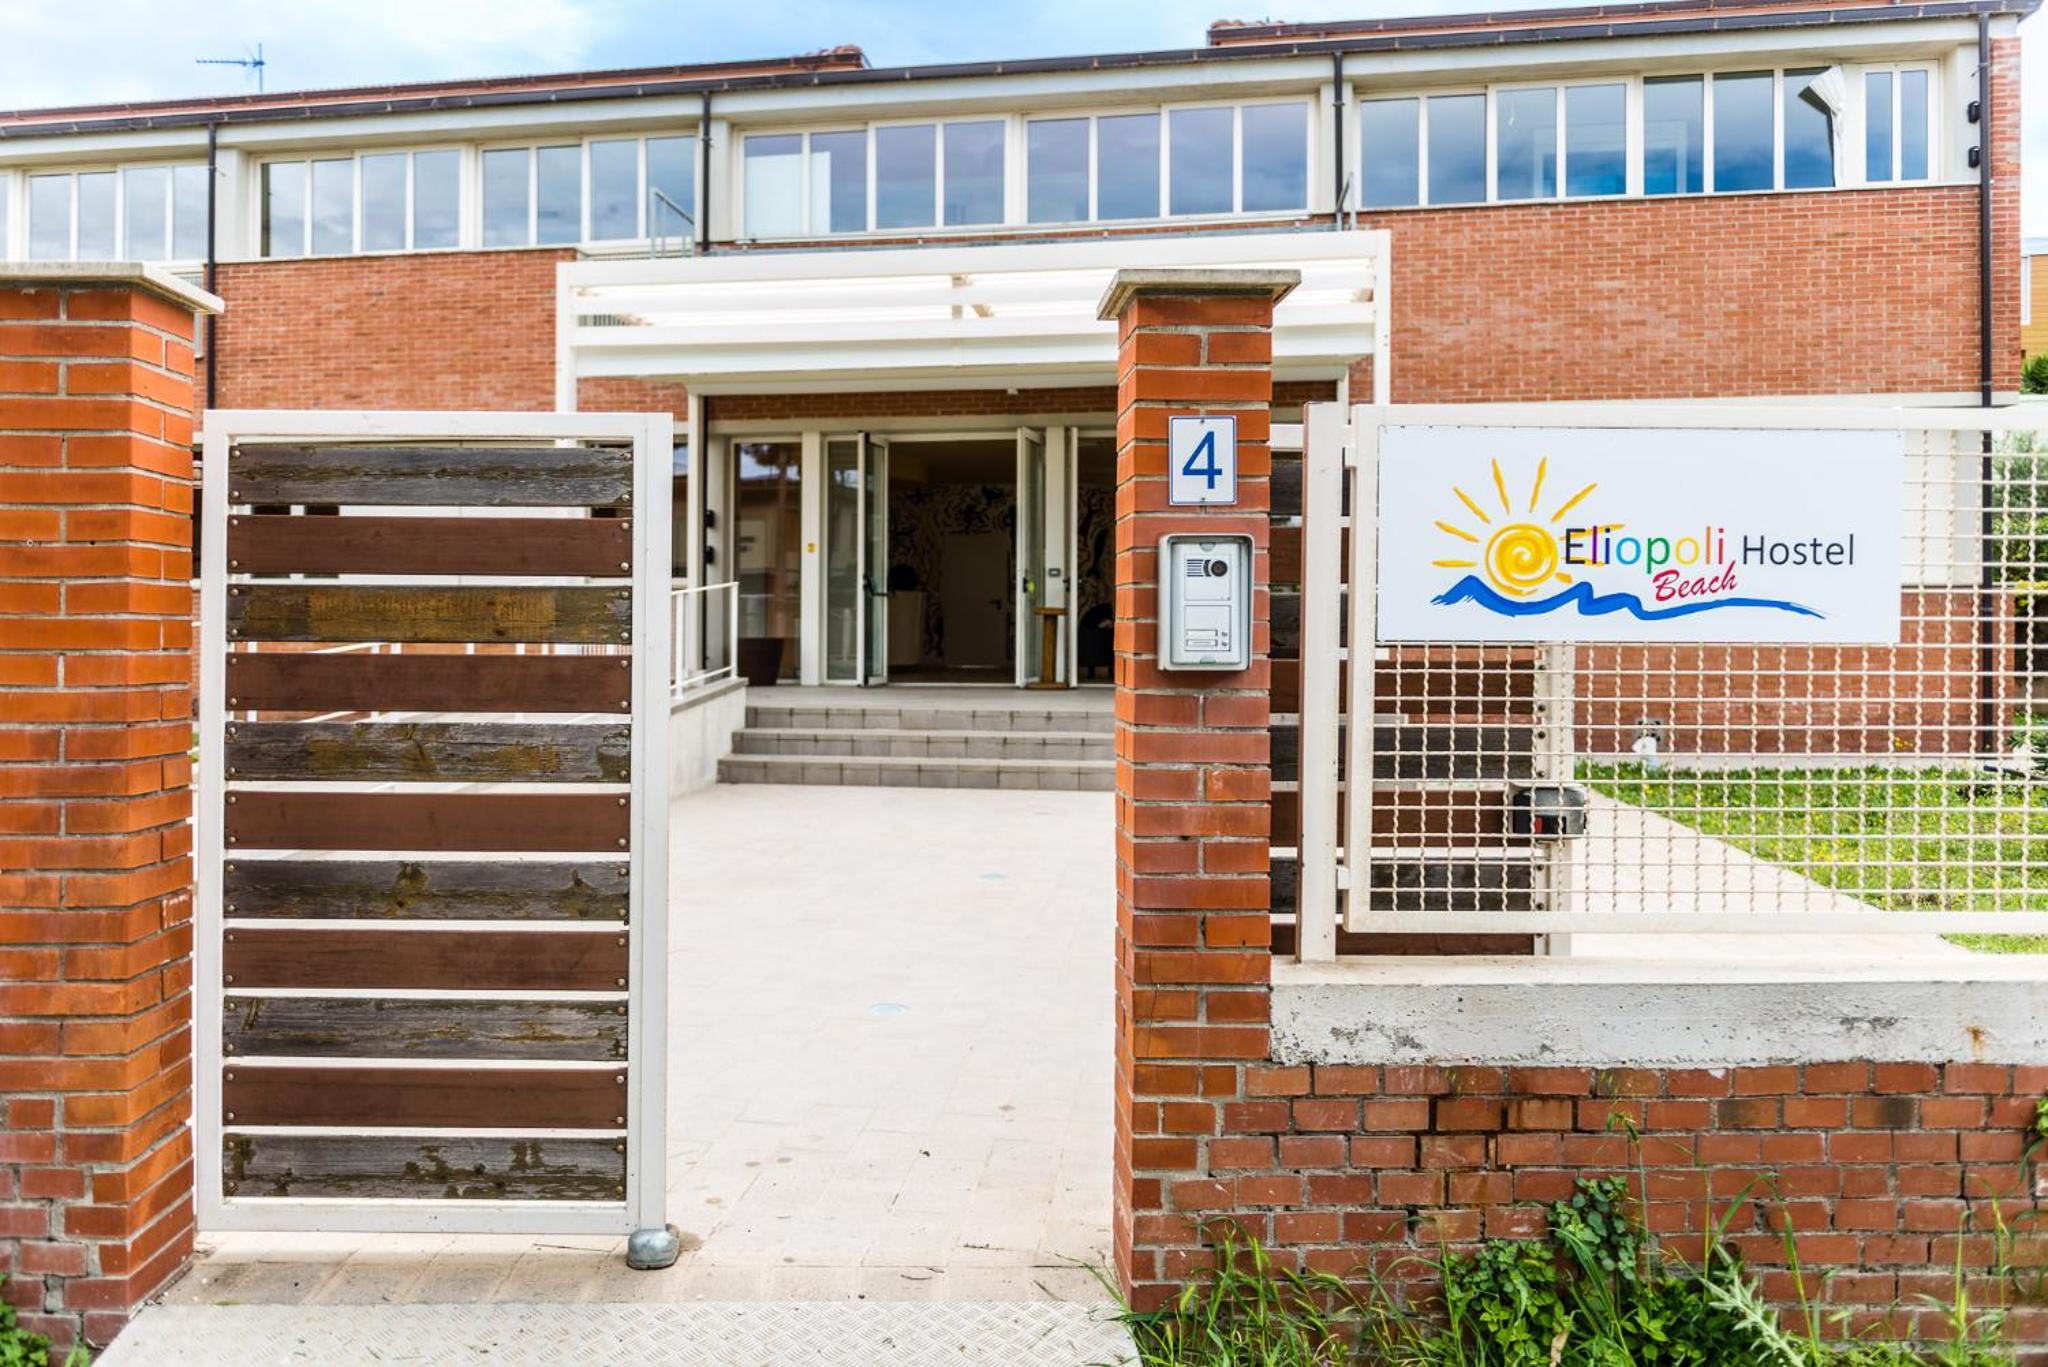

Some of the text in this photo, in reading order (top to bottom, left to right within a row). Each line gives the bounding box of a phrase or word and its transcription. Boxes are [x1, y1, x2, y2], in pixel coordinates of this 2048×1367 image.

[1182, 430, 1223, 489] 4
[1566, 526, 1855, 574] Eliopoli Hostel
[1653, 560, 1738, 602] Beach
